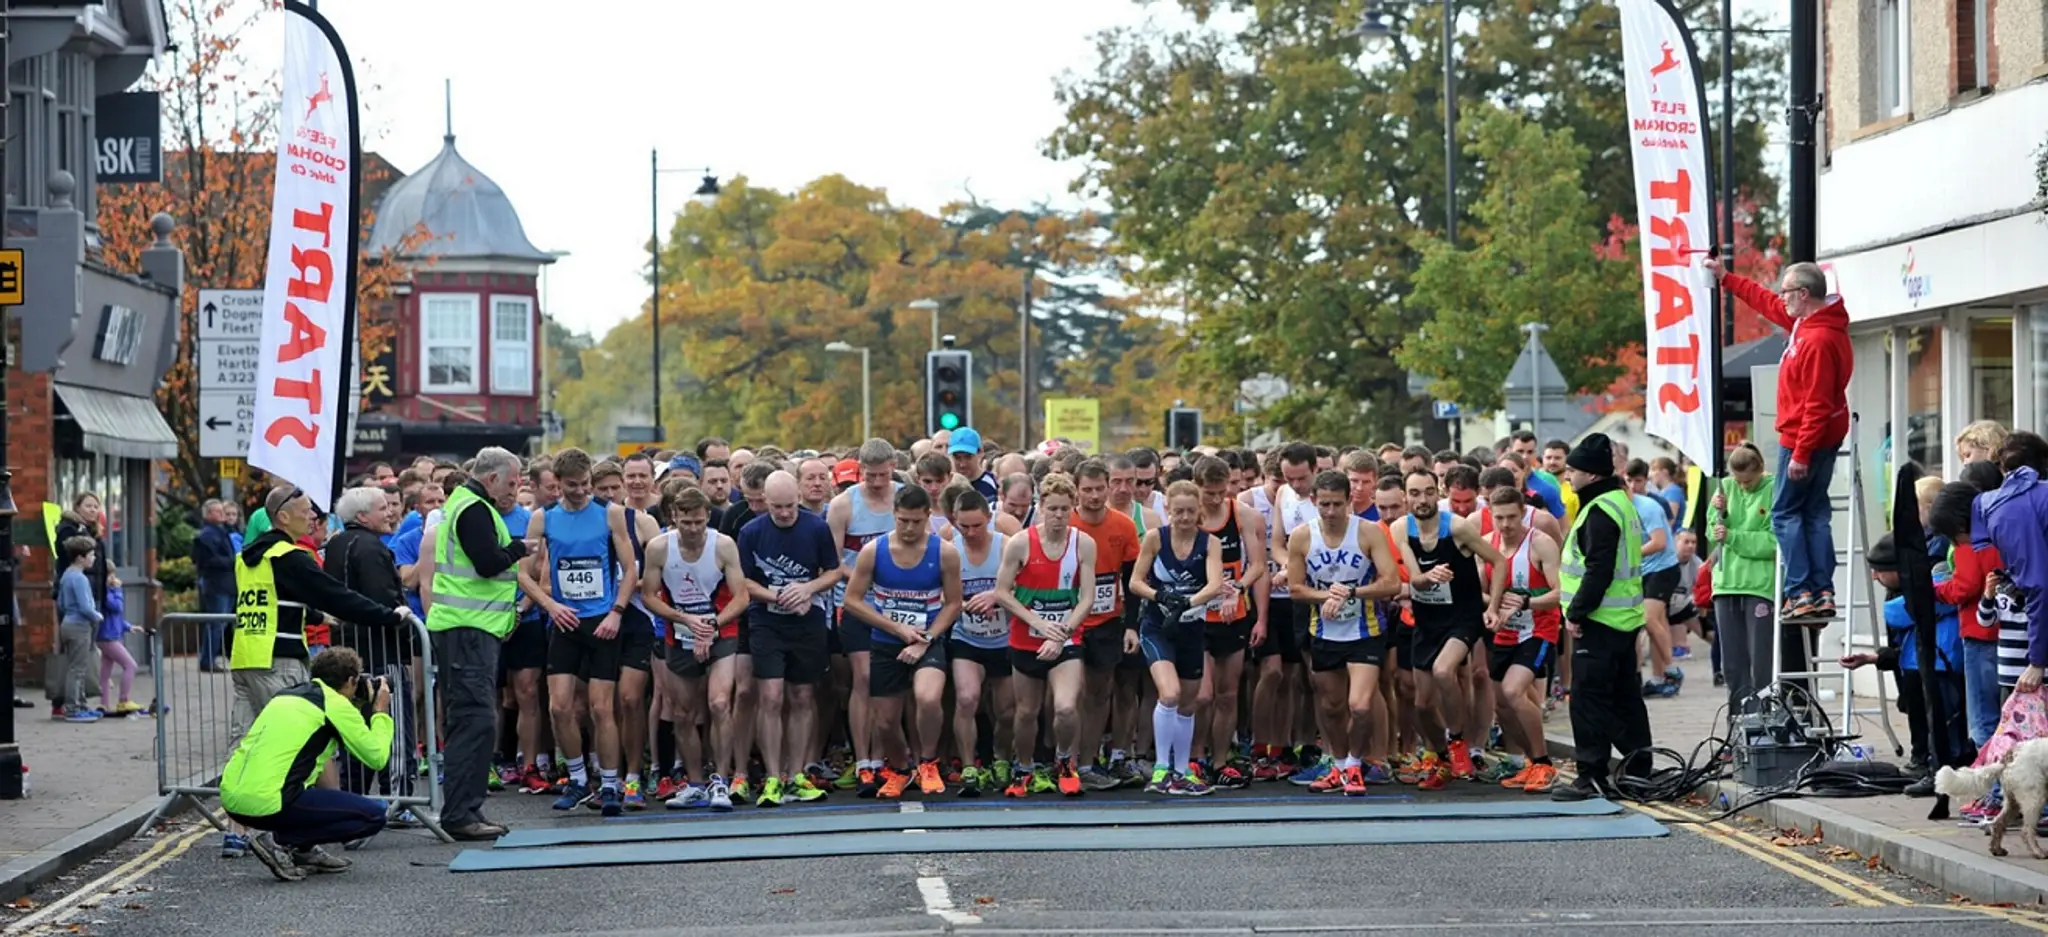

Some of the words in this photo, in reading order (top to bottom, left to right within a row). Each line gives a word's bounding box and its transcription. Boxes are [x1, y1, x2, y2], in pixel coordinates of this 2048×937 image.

[95, 136, 135, 174] ASK
[237, 408, 254, 420] Ch
[777, 554, 810, 576] HART
[1308, 549, 1363, 572] LUKE
[567, 571, 593, 584] 446
[238, 589, 269, 607] ACE
[1097, 586, 1113, 599] 55
[890, 611, 917, 626] 872
[1039, 613, 1065, 623] 797
